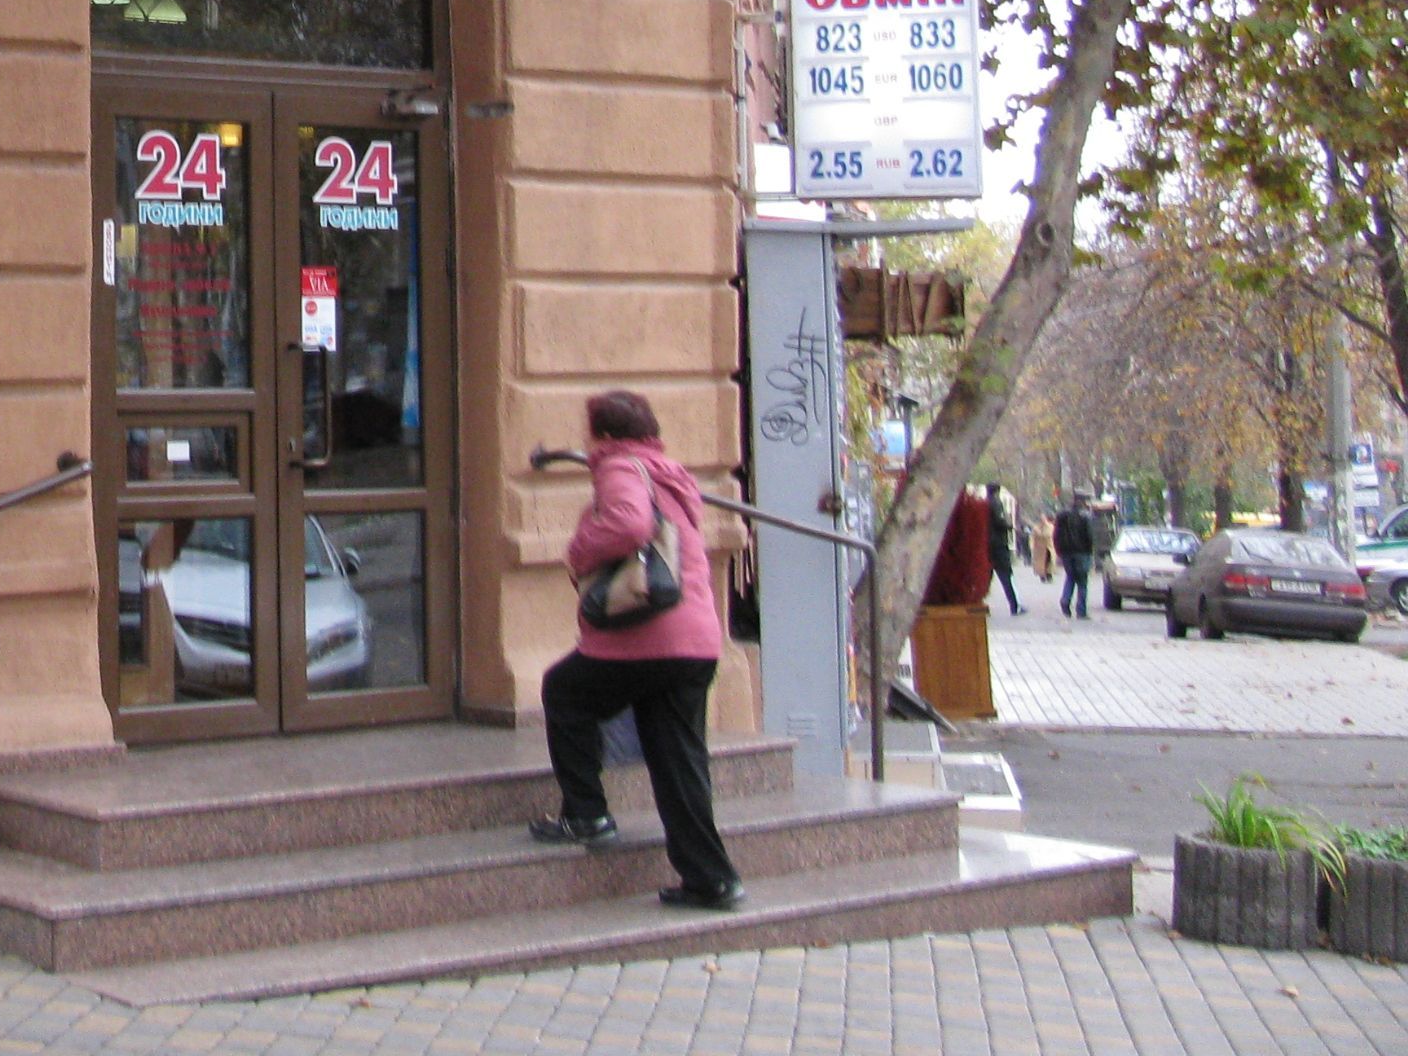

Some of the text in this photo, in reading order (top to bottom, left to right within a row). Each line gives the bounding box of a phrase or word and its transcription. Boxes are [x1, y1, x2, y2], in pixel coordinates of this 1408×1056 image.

[816, 22, 862, 53] 823
[909, 19, 956, 49] 833
[809, 62, 963, 95] 1045 EUR 1060
[135, 129, 227, 202] 24
[312, 136, 398, 206] 24
[810, 149, 863, 179] 2.55
[909, 148, 964, 177] 2.62
